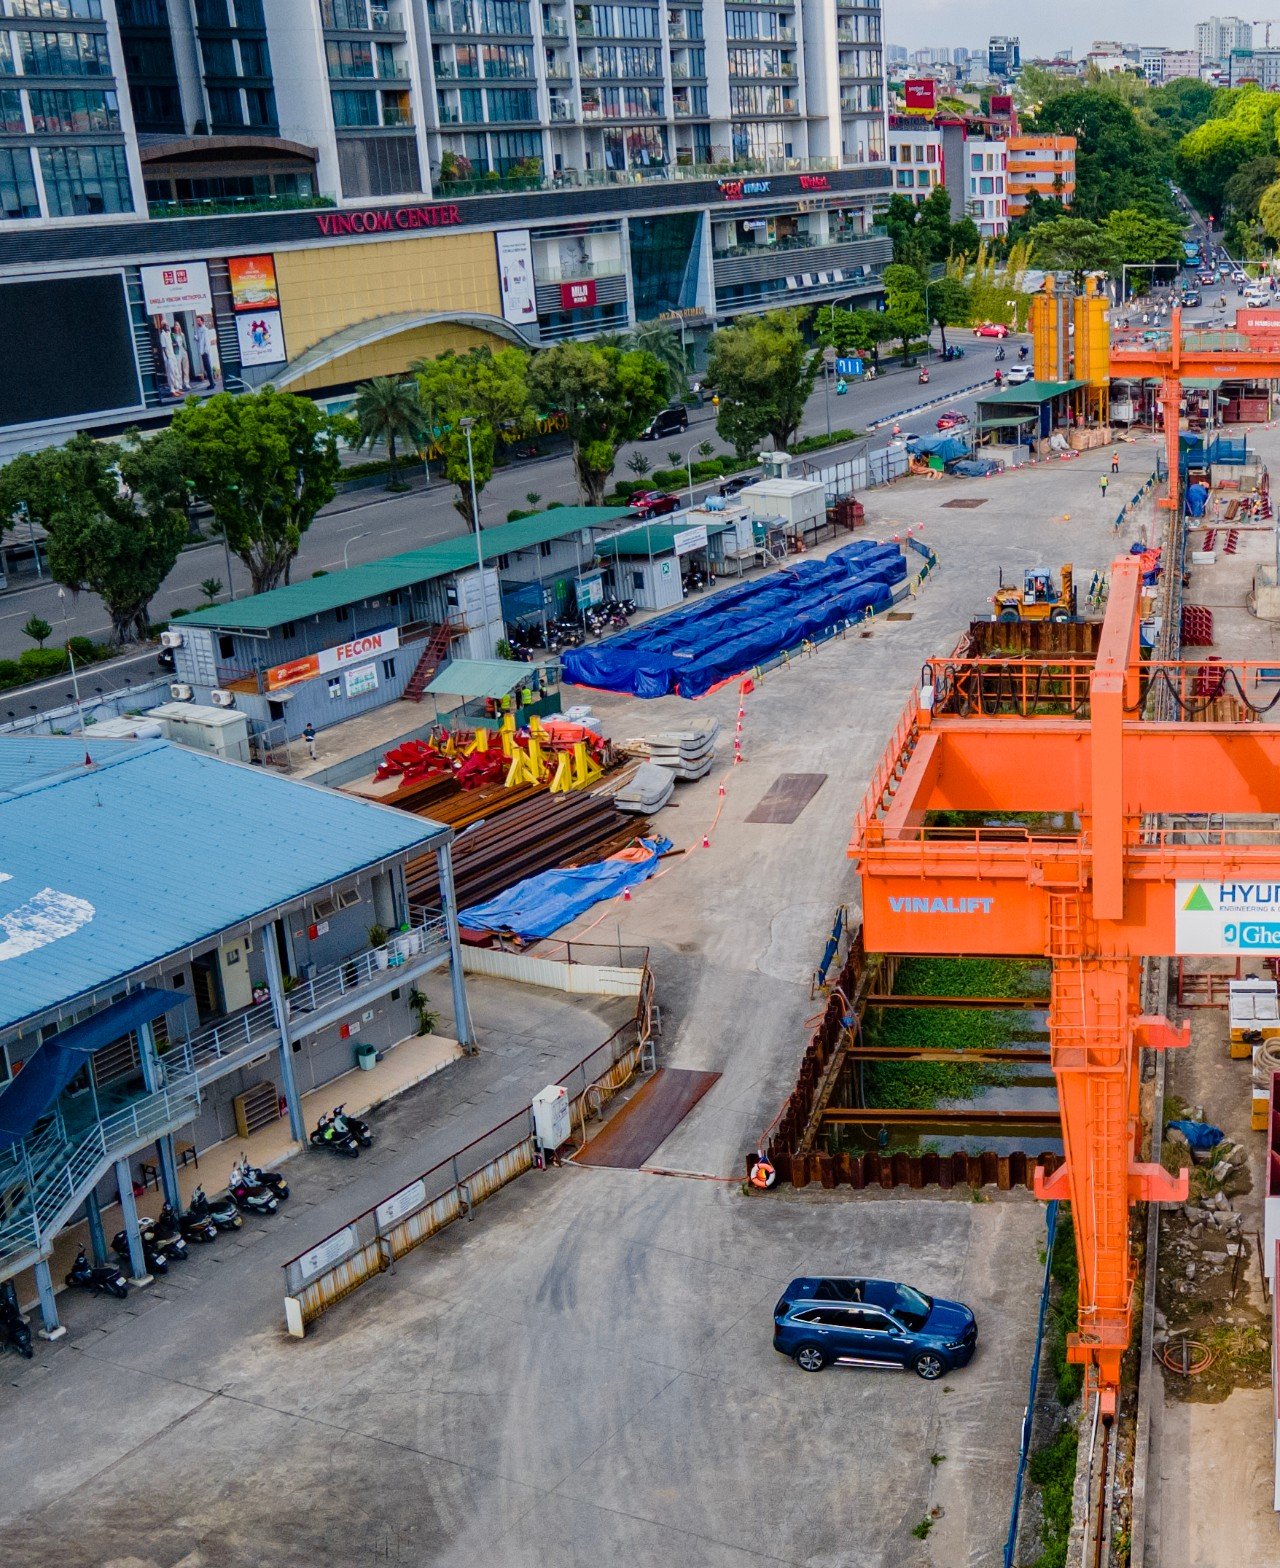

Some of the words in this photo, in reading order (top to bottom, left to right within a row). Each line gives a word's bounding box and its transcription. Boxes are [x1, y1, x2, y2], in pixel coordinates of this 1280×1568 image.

[744, 180, 771, 194] IMAX
[317, 211, 394, 235] VINCOM
[395, 204, 462, 228] CENTER
[336, 634, 383, 661] FECON
[888, 896, 994, 913] VINALIFT
